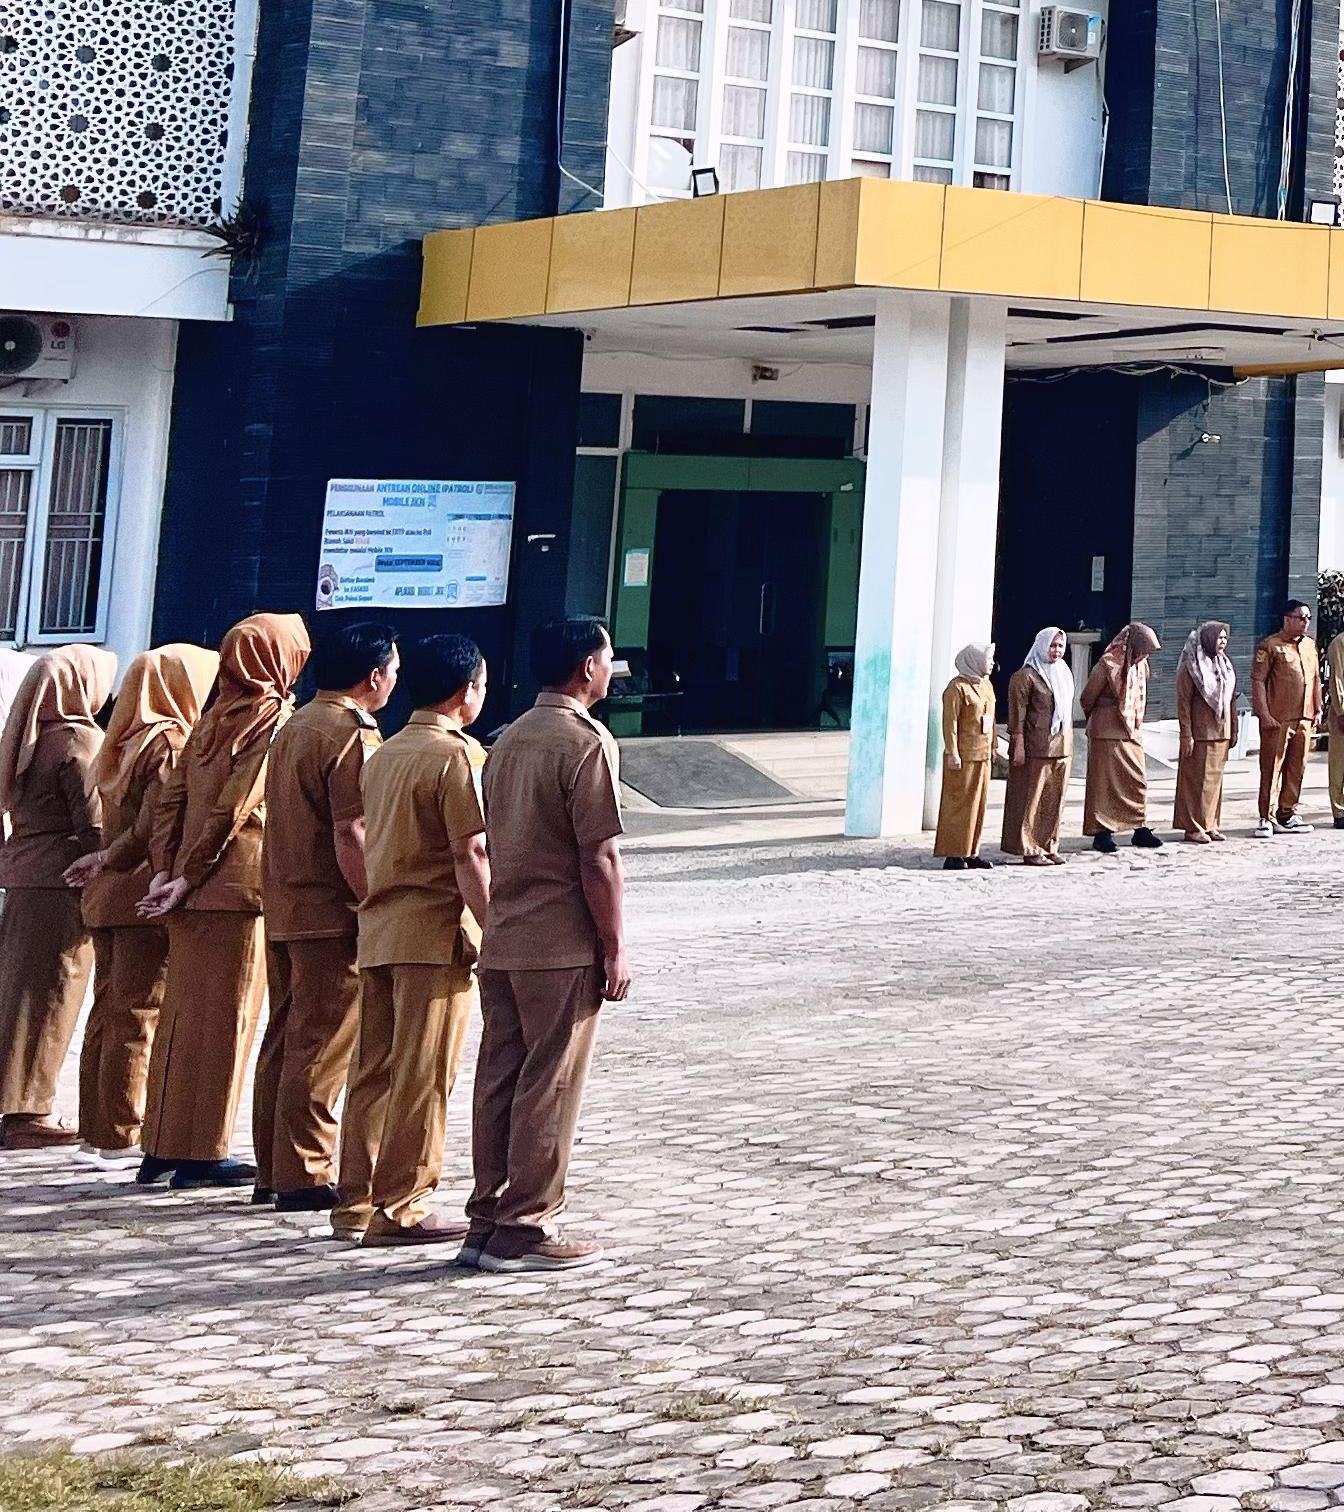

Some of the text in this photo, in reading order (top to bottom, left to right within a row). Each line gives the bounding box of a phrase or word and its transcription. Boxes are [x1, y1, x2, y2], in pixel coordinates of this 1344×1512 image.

[51, 340, 66, 350] LG
[376, 483, 410, 493] ANTREAN
[411, 484, 441, 493] ONLINE
[383, 497, 409, 506] MOBILE
